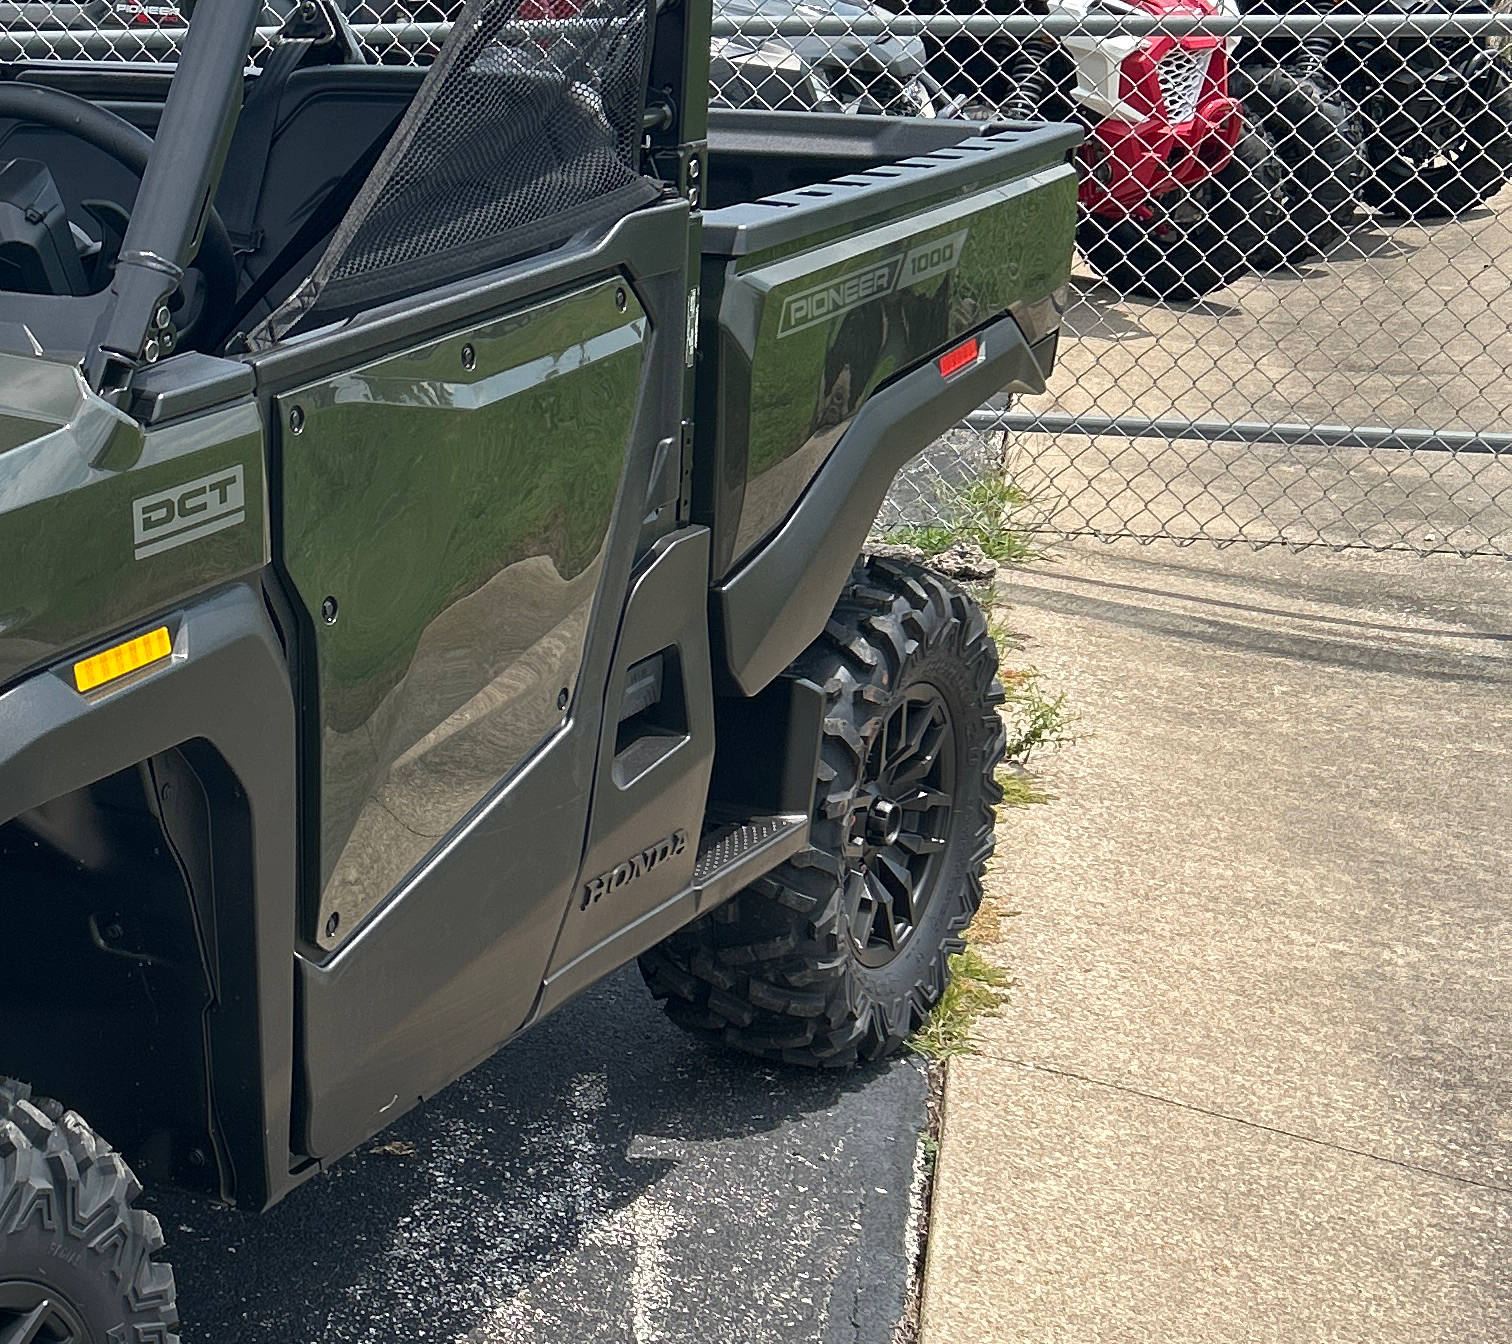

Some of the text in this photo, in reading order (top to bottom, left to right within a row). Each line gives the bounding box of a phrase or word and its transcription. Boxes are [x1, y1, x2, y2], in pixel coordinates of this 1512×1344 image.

[790, 242, 955, 327] PIONEER 1000
[141, 474, 237, 533] DCT
[580, 828, 688, 912] HONDA
